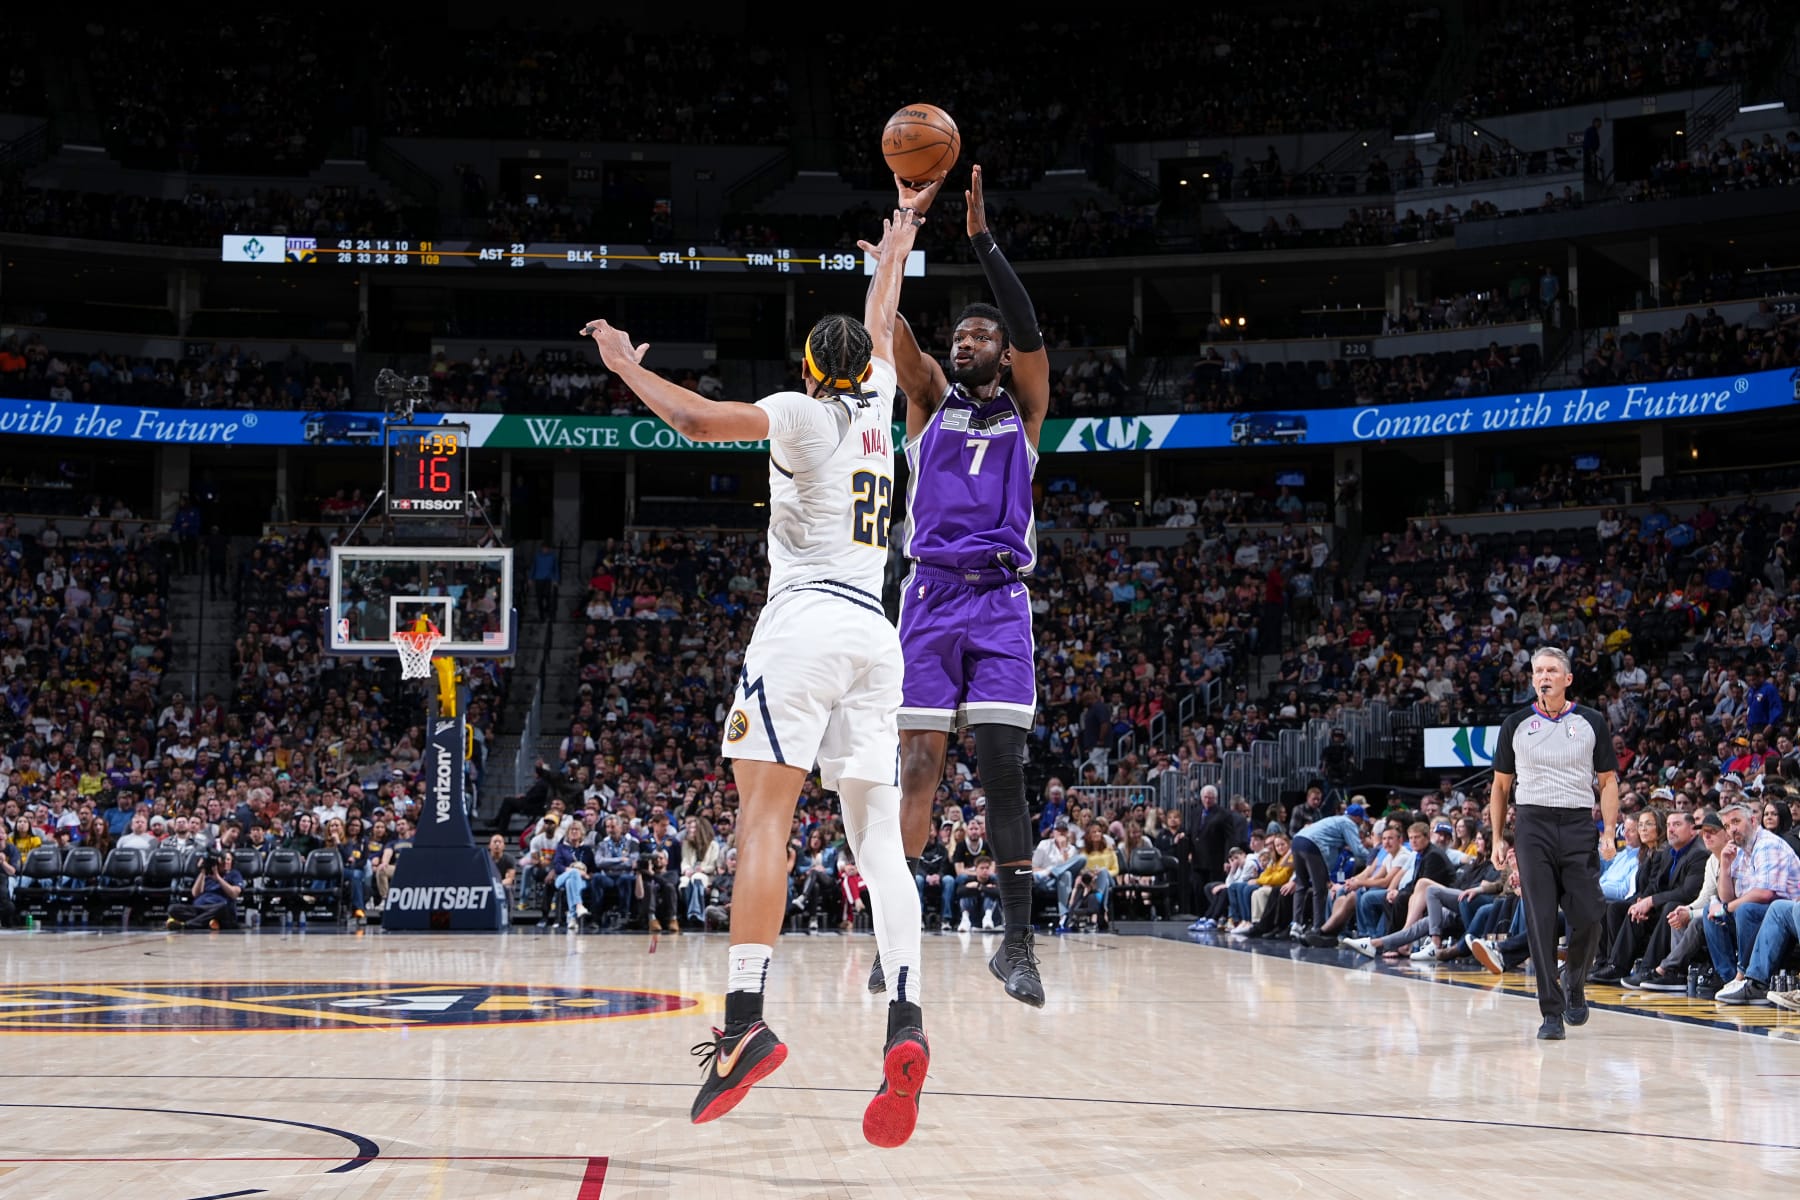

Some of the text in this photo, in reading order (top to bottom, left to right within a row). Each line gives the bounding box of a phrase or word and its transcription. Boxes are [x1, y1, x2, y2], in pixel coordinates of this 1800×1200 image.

[338, 240, 433, 252] 43 24 14 10 91
[511, 244, 525, 254] 23
[600, 245, 608, 256] 5
[479, 249, 504, 260] AST
[567, 251, 593, 262] BLK
[688, 247, 696, 257] 6
[777, 249, 790, 259] 16
[356, 253, 371, 263] 33
[375, 253, 389, 264] 24
[511, 257, 525, 267] 25
[600, 258, 608, 269] 2
[658, 252, 683, 264] STL
[746, 254, 773, 266] TRN
[818, 254, 856, 270] 1:39
[689, 260, 701, 270] 11
[777, 262, 790, 272] 15
[1345, 343, 1367, 354] 220
[1352, 407, 1474, 439] Connect
[1482, 392, 1552, 429] with
[1562, 389, 1611, 424] the
[73, 405, 123, 437] the
[940, 408, 1018, 436] SAC
[419, 434, 458, 455] 1:39
[965, 438, 991, 476] 7
[419, 456, 451, 492] 16
[411, 500, 463, 510] TISSOT
[852, 468, 892, 550] 22
[433, 751, 452, 824] verizon
[386, 886, 492, 911] POINTSBET
